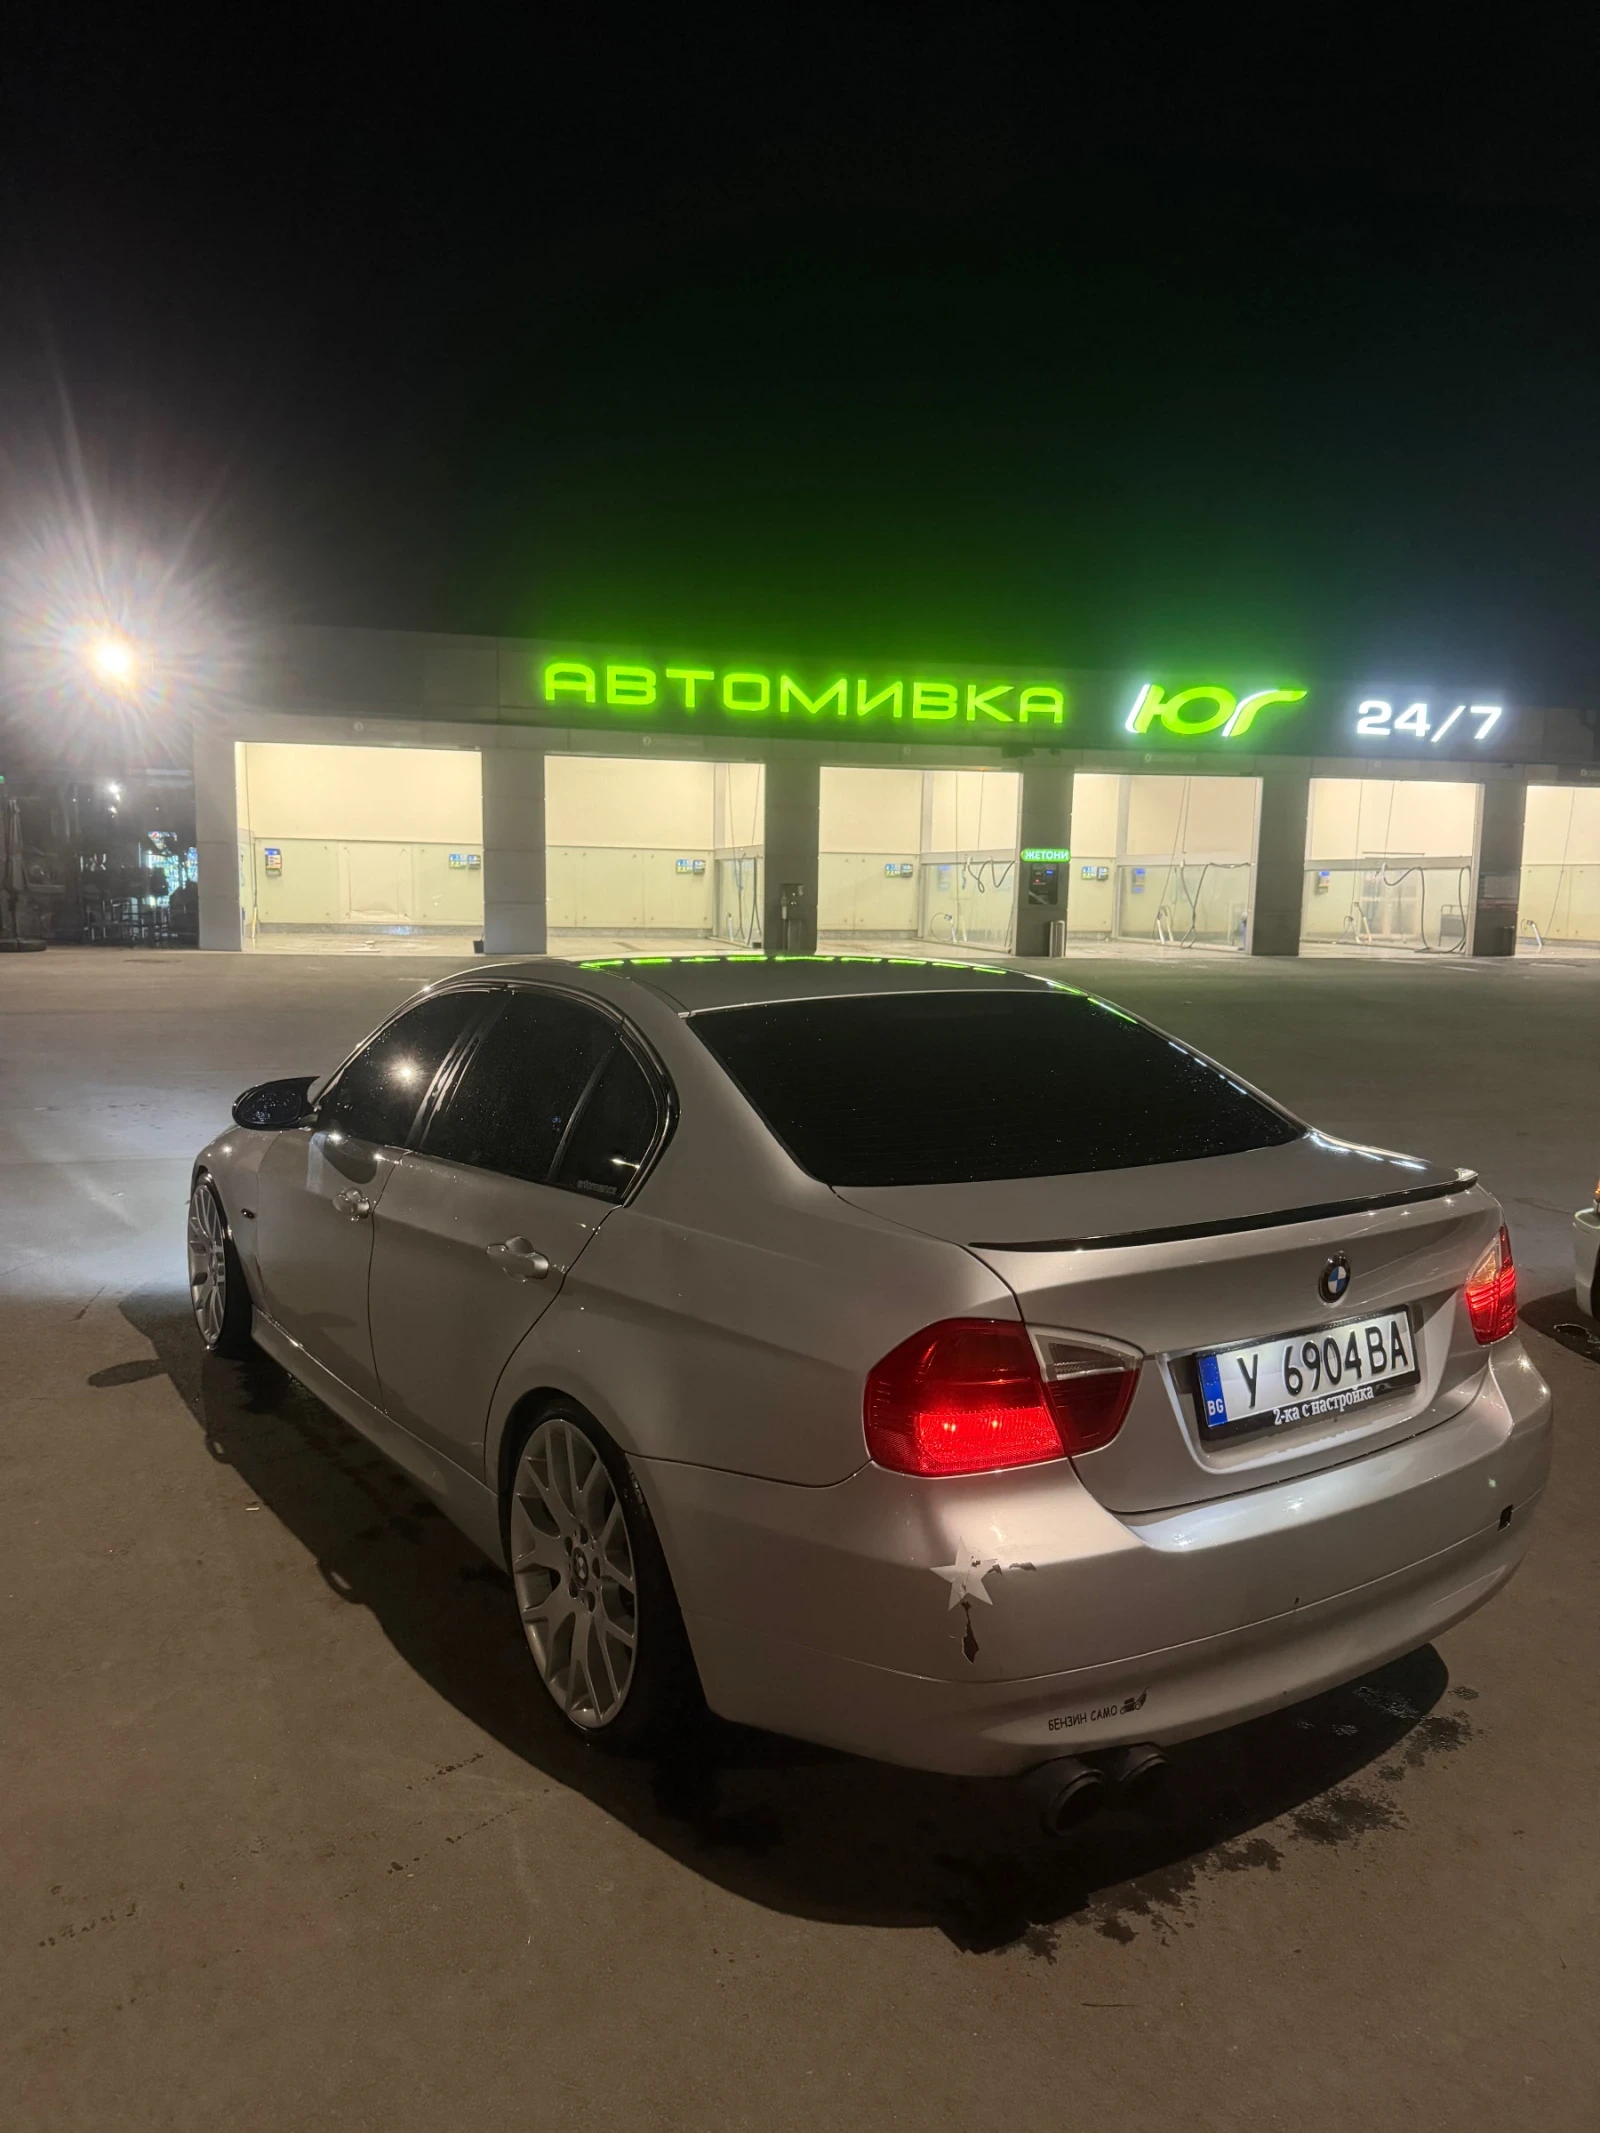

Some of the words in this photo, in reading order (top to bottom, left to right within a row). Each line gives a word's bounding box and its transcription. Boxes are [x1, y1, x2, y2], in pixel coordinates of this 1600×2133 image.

[544, 662, 1064, 724] АВТОМИВКА
[1357, 700, 1502, 742] 24/7
[1025, 850, 1069, 860] ЖЕТОНИ
[1207, 1398, 1225, 1416] BG
[1311, 1384, 1374, 1416] настройка
[1048, 1712, 1087, 1731] БЕНЗИН
[1090, 1705, 1117, 1722] САМО
